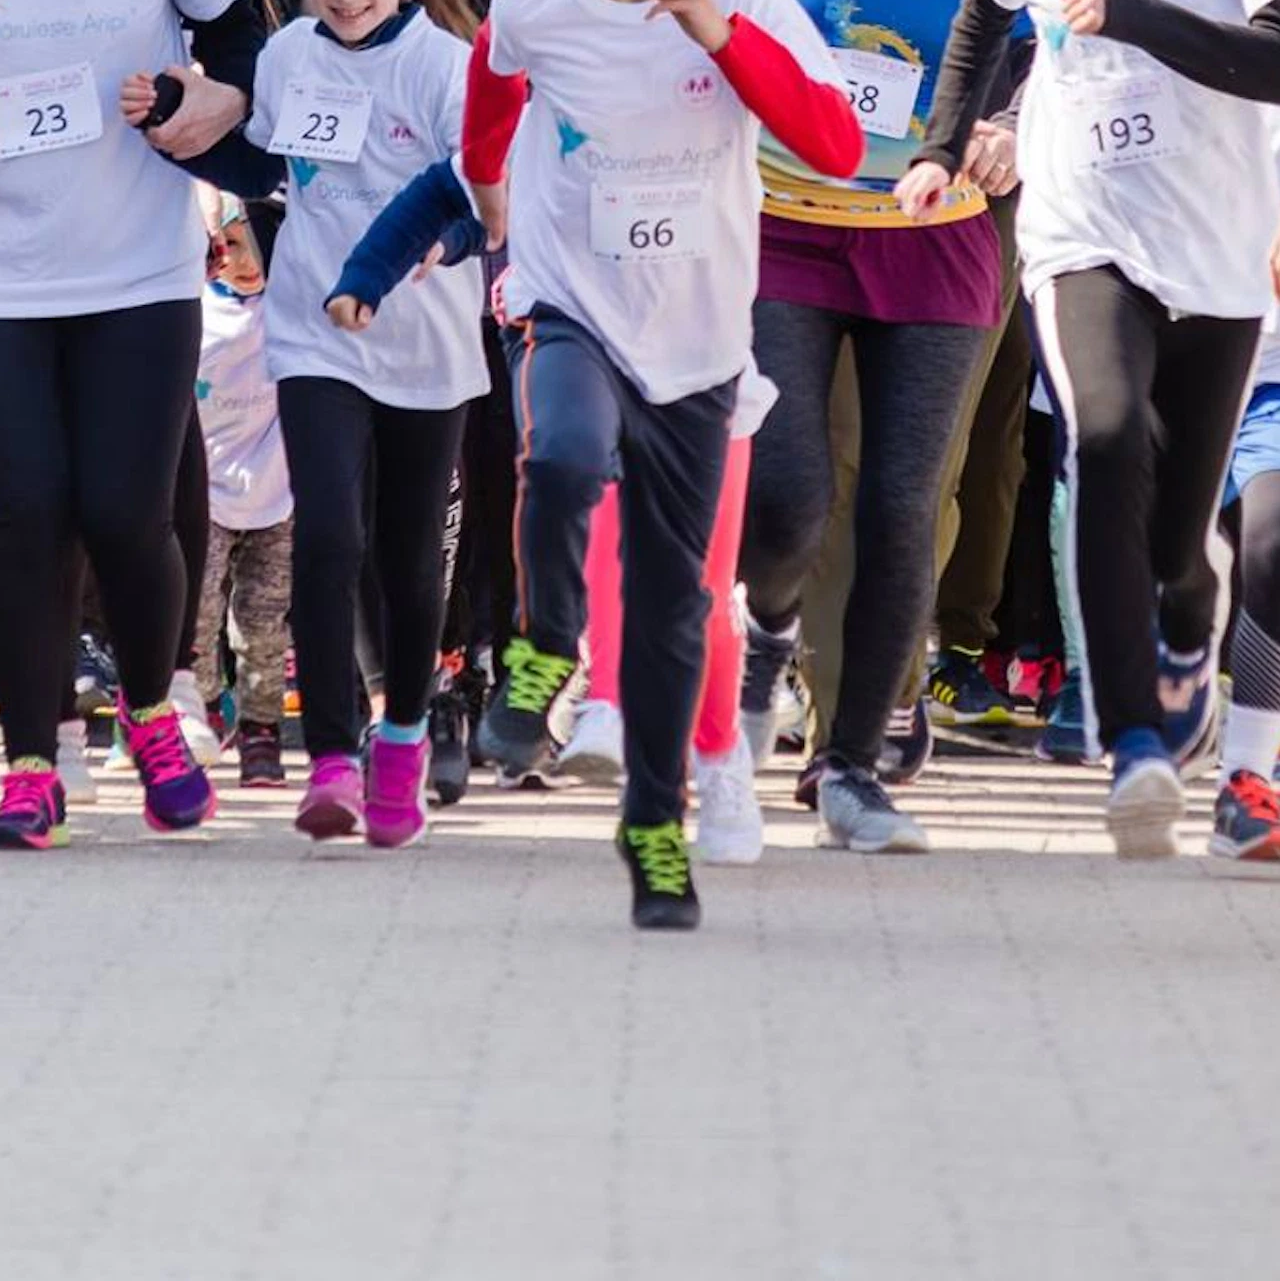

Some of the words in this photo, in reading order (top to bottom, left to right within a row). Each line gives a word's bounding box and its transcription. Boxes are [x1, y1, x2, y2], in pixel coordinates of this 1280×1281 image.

[25, 104, 68, 136] 23
[302, 112, 340, 142] 23
[1090, 113, 1155, 152] 193
[629, 218, 674, 249] 66
